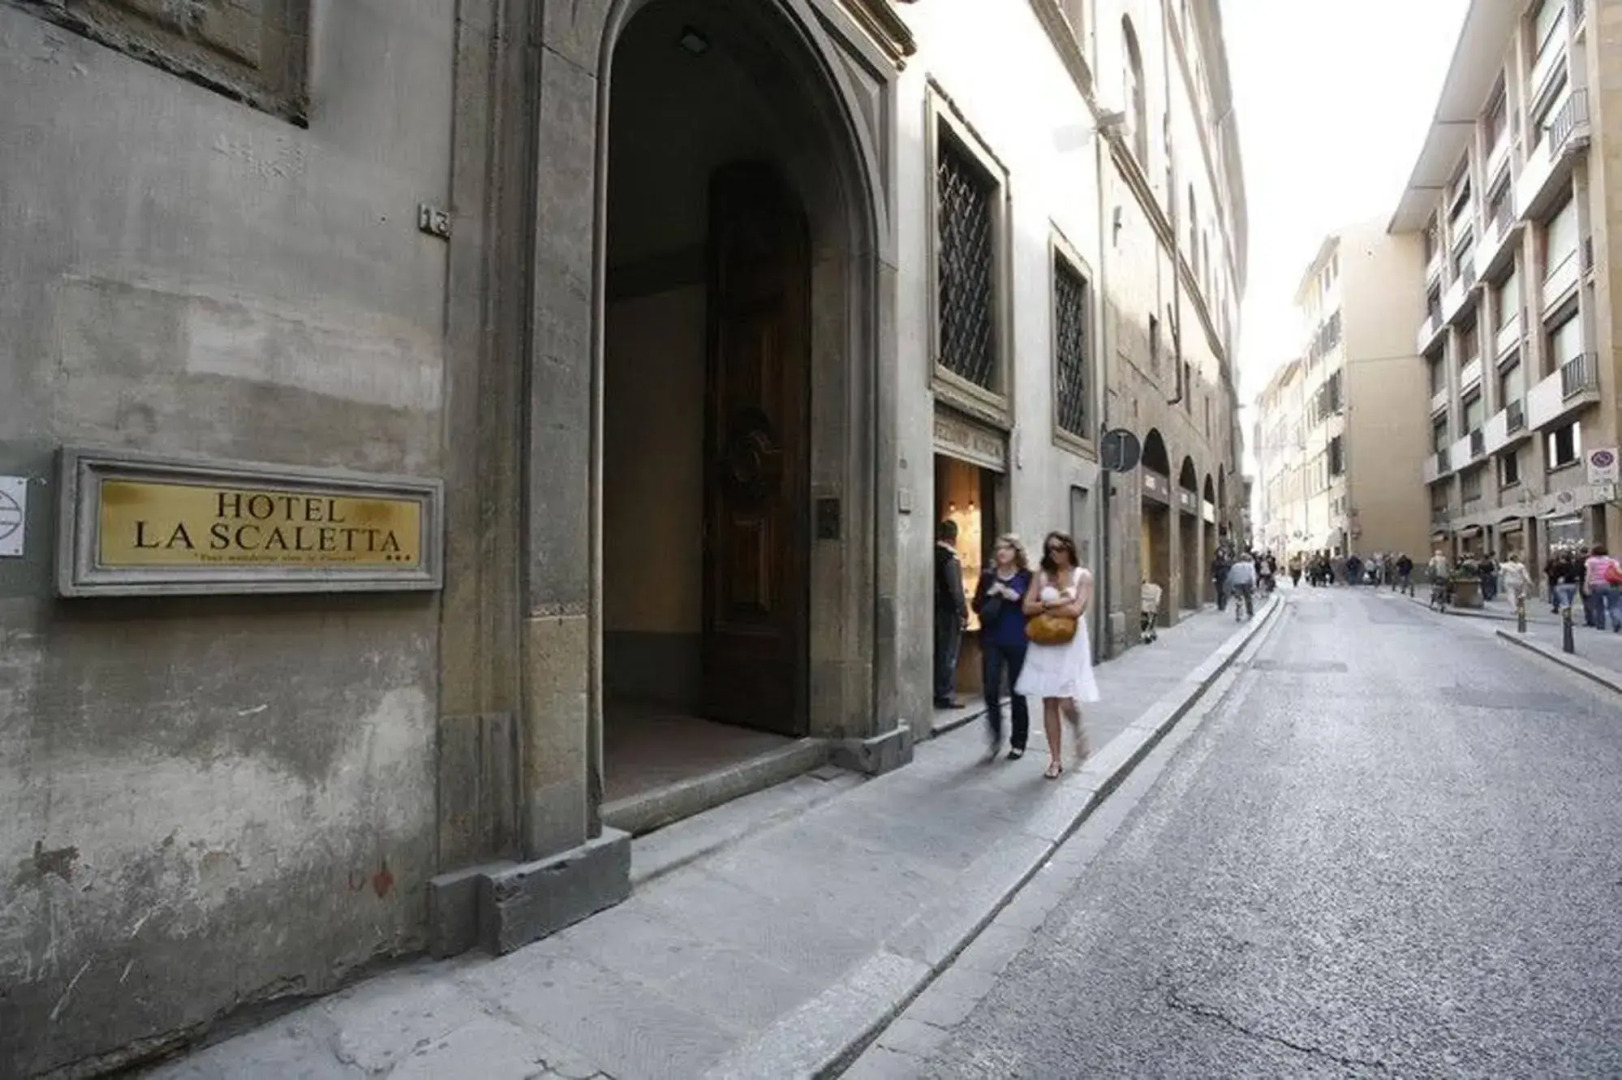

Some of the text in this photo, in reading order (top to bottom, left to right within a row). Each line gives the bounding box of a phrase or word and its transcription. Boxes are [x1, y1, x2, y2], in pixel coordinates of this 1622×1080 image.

[216, 492, 346, 523] HOTEL
[134, 520, 400, 552] LA SCALETTA
